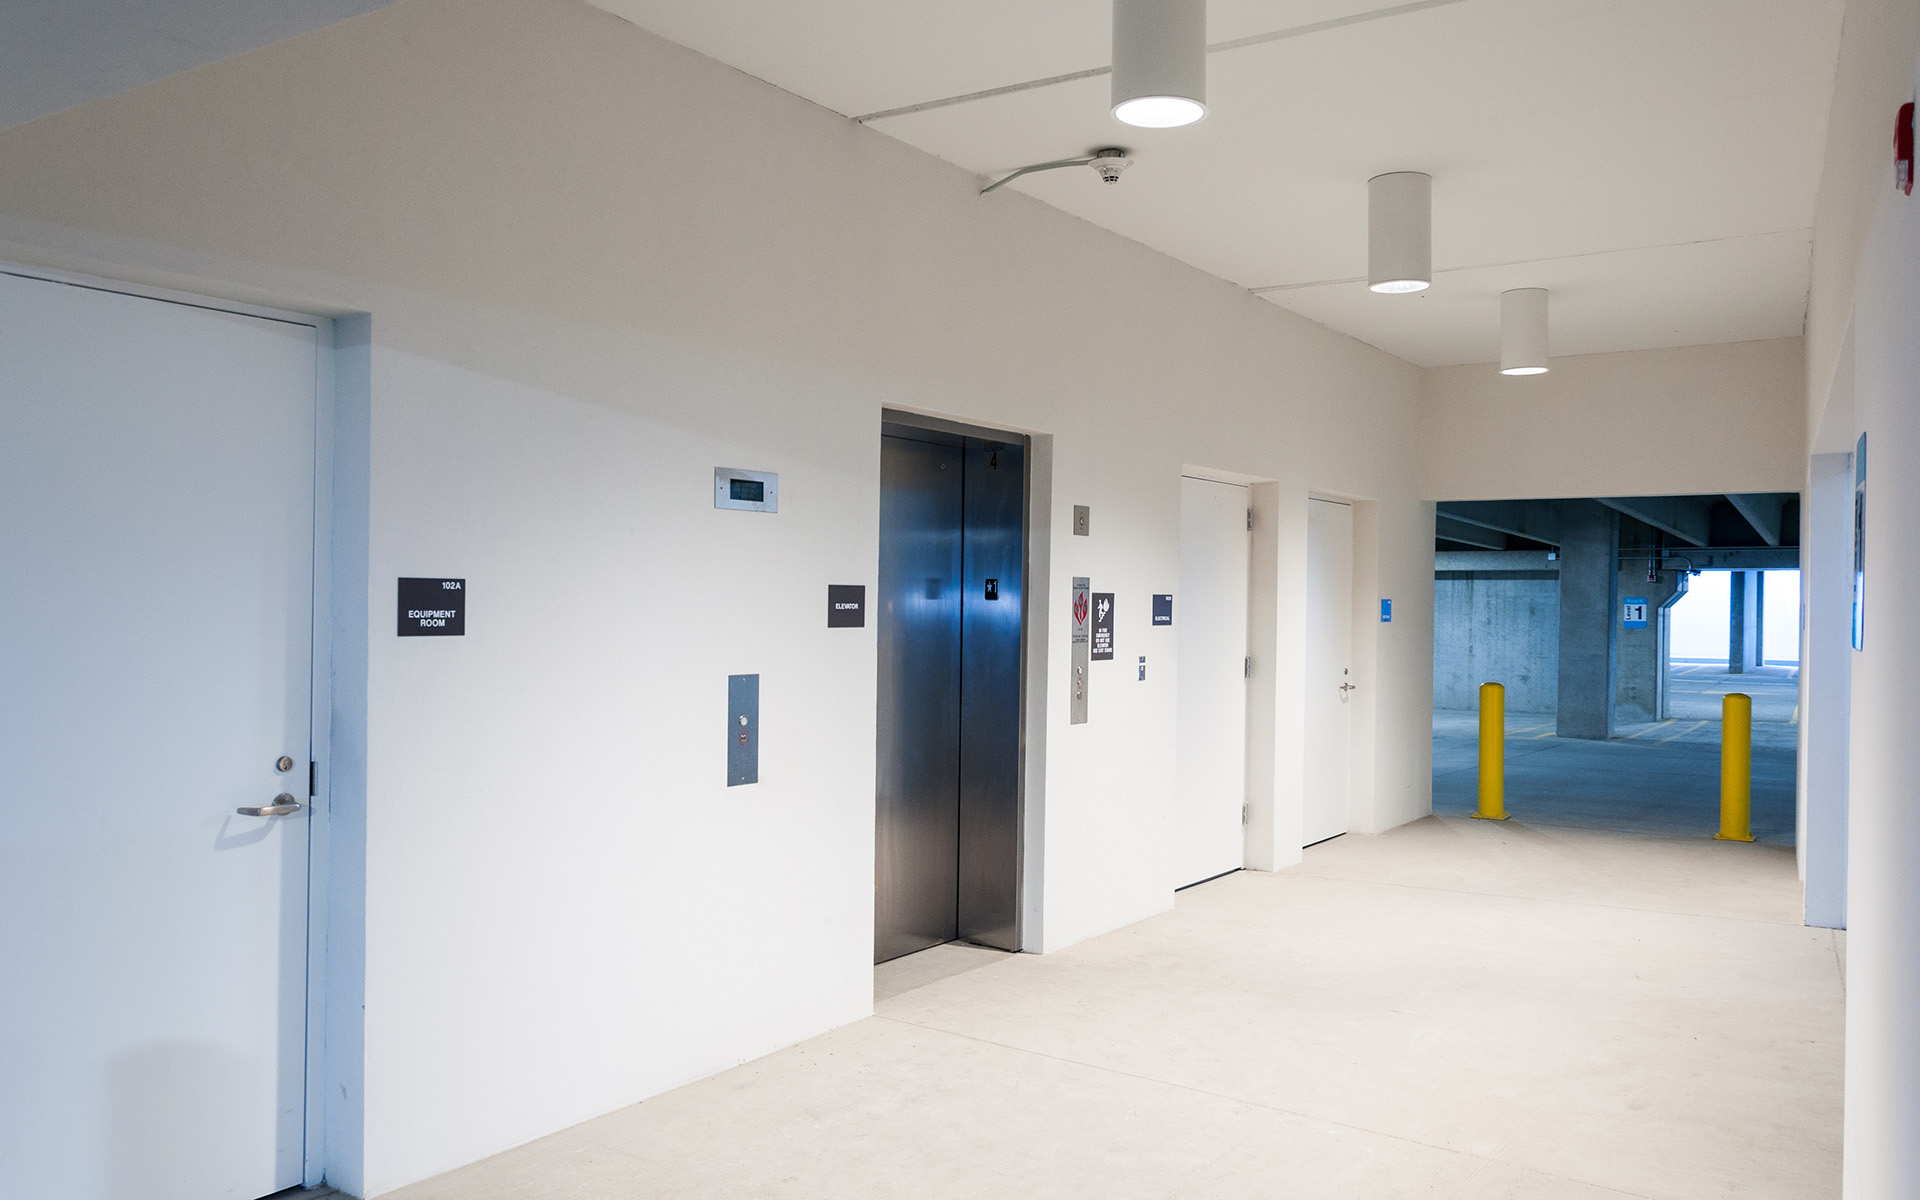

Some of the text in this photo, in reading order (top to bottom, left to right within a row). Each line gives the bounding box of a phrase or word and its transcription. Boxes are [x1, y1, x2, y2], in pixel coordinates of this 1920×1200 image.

[990, 452, 998, 470] 4
[442, 581, 461, 590] 102A
[835, 602, 859, 610] ELEVATOR
[408, 610, 456, 618] EQUIPMENT
[1634, 605, 1643, 620] 1
[420, 619, 445, 627] ROOM
